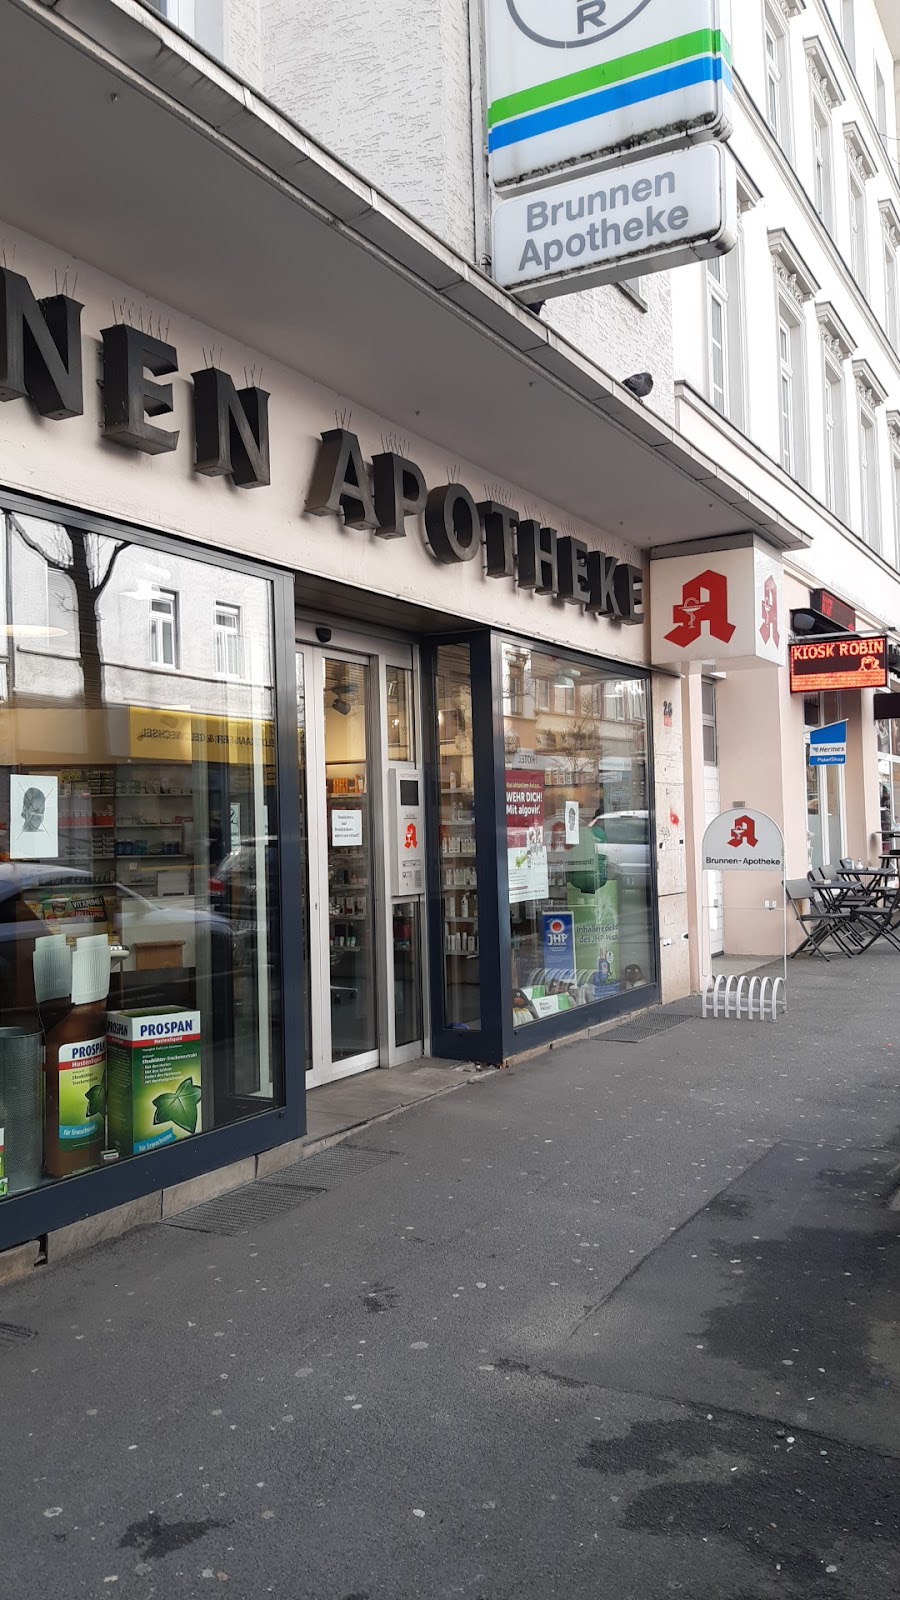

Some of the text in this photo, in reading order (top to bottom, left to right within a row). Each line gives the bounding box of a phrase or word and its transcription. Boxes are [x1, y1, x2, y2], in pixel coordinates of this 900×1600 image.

[526, 171, 676, 233] Brunnen
[518, 204, 690, 272] Apotheke
[304, 428, 645, 626] APOTHEKE
[793, 640, 883, 660] KIOSK ROBIN
[663, 701, 672, 716] 26
[505, 791, 543, 803] WEHR DICH!
[505, 804, 518, 815] Mit
[547, 933, 568, 946] JHP
[107, 1021, 128, 1037] PROSPAN
[140, 1019, 193, 1037] PROSPAN
